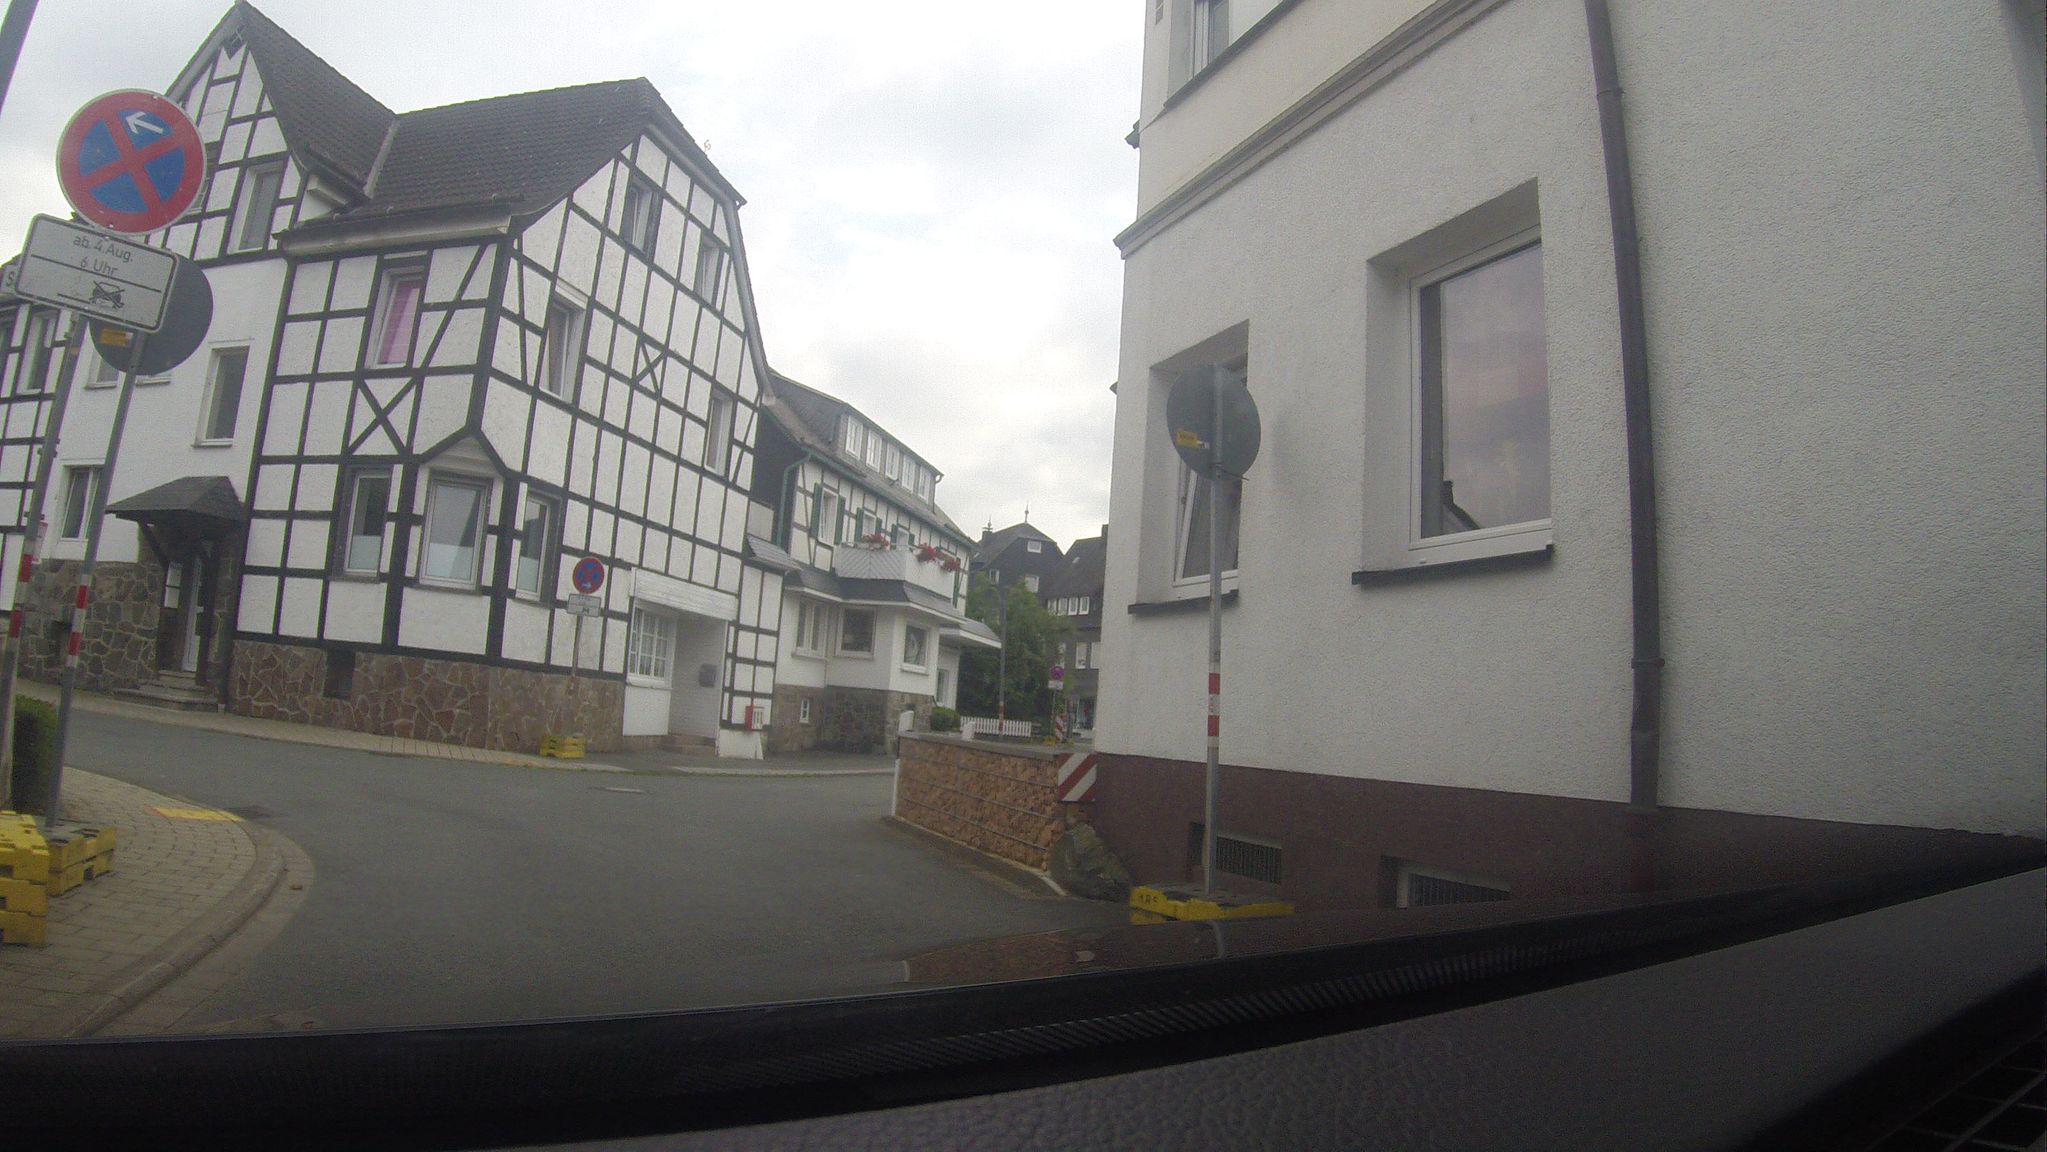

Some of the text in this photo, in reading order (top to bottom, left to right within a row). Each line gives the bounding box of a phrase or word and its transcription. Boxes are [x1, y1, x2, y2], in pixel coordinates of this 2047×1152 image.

[73, 235, 89, 249] ab
[80, 255, 118, 276] 6 Uhr
